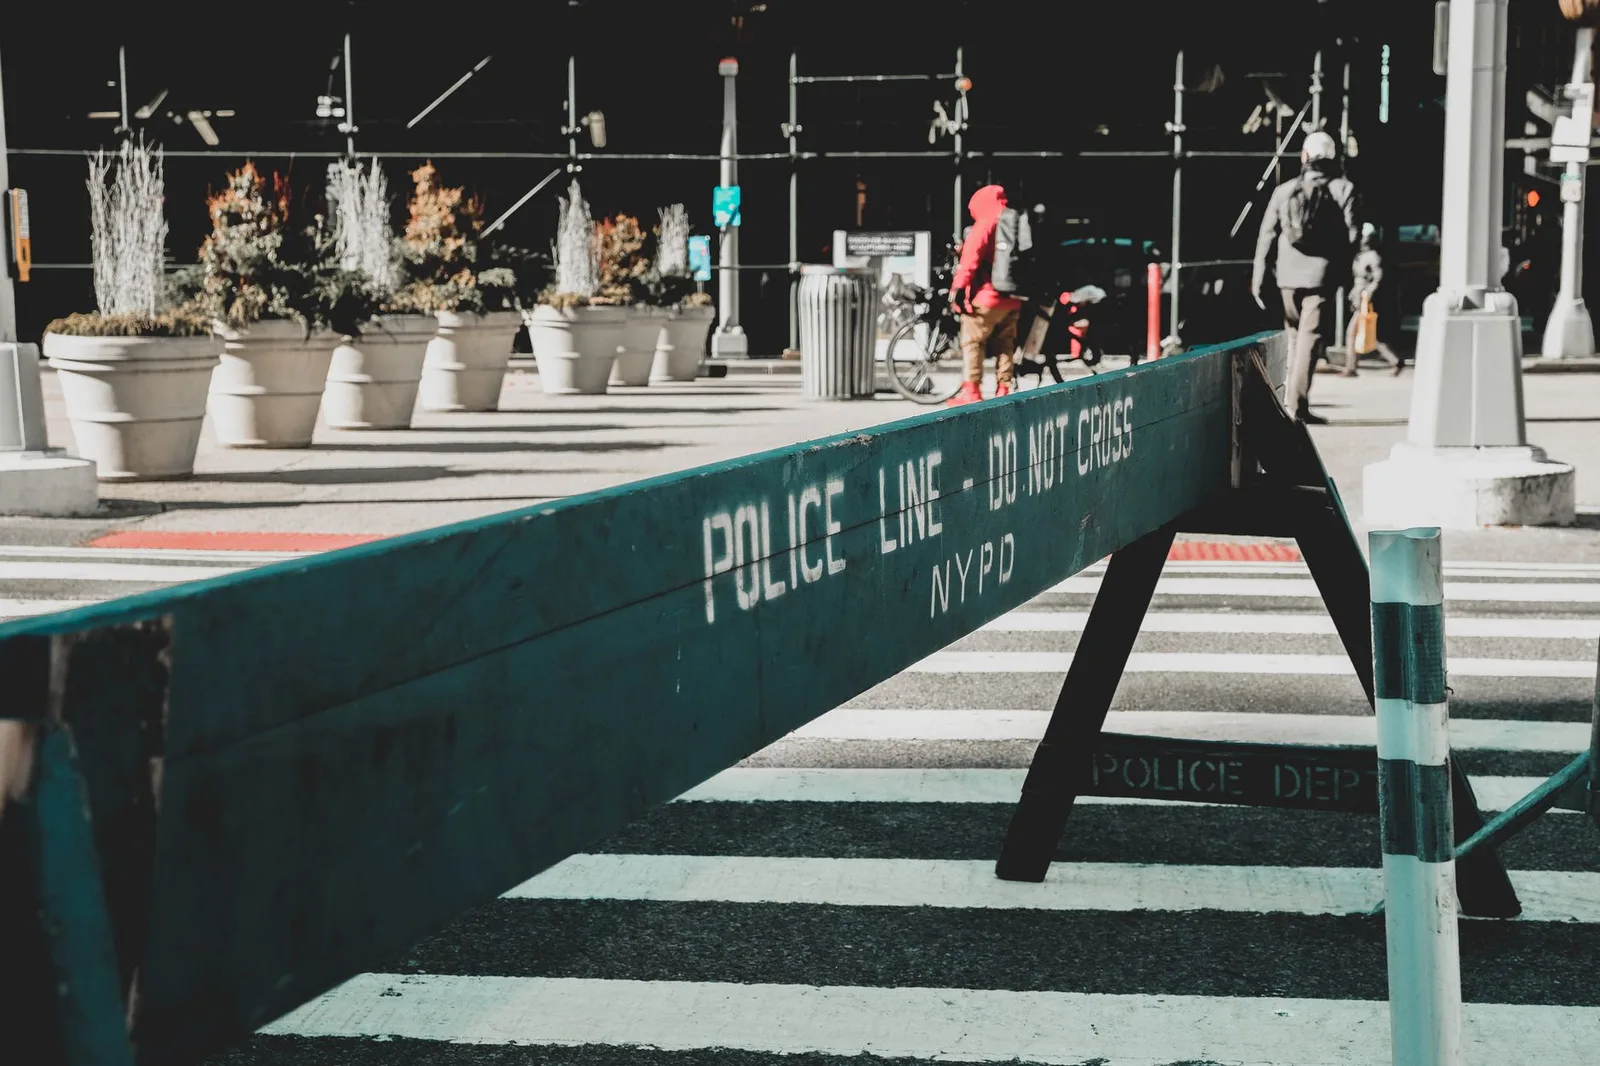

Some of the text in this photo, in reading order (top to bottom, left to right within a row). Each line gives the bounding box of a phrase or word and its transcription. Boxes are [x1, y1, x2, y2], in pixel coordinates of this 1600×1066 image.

[703, 477, 847, 625] POLICE
[879, 450, 943, 555] LINE
[989, 429, 1017, 512] DO
[1028, 412, 1068, 497] NOT
[1077, 396, 1134, 477] CROSS
[930, 532, 1015, 619] NYPD
[1092, 753, 1379, 801] POLICE DEP
